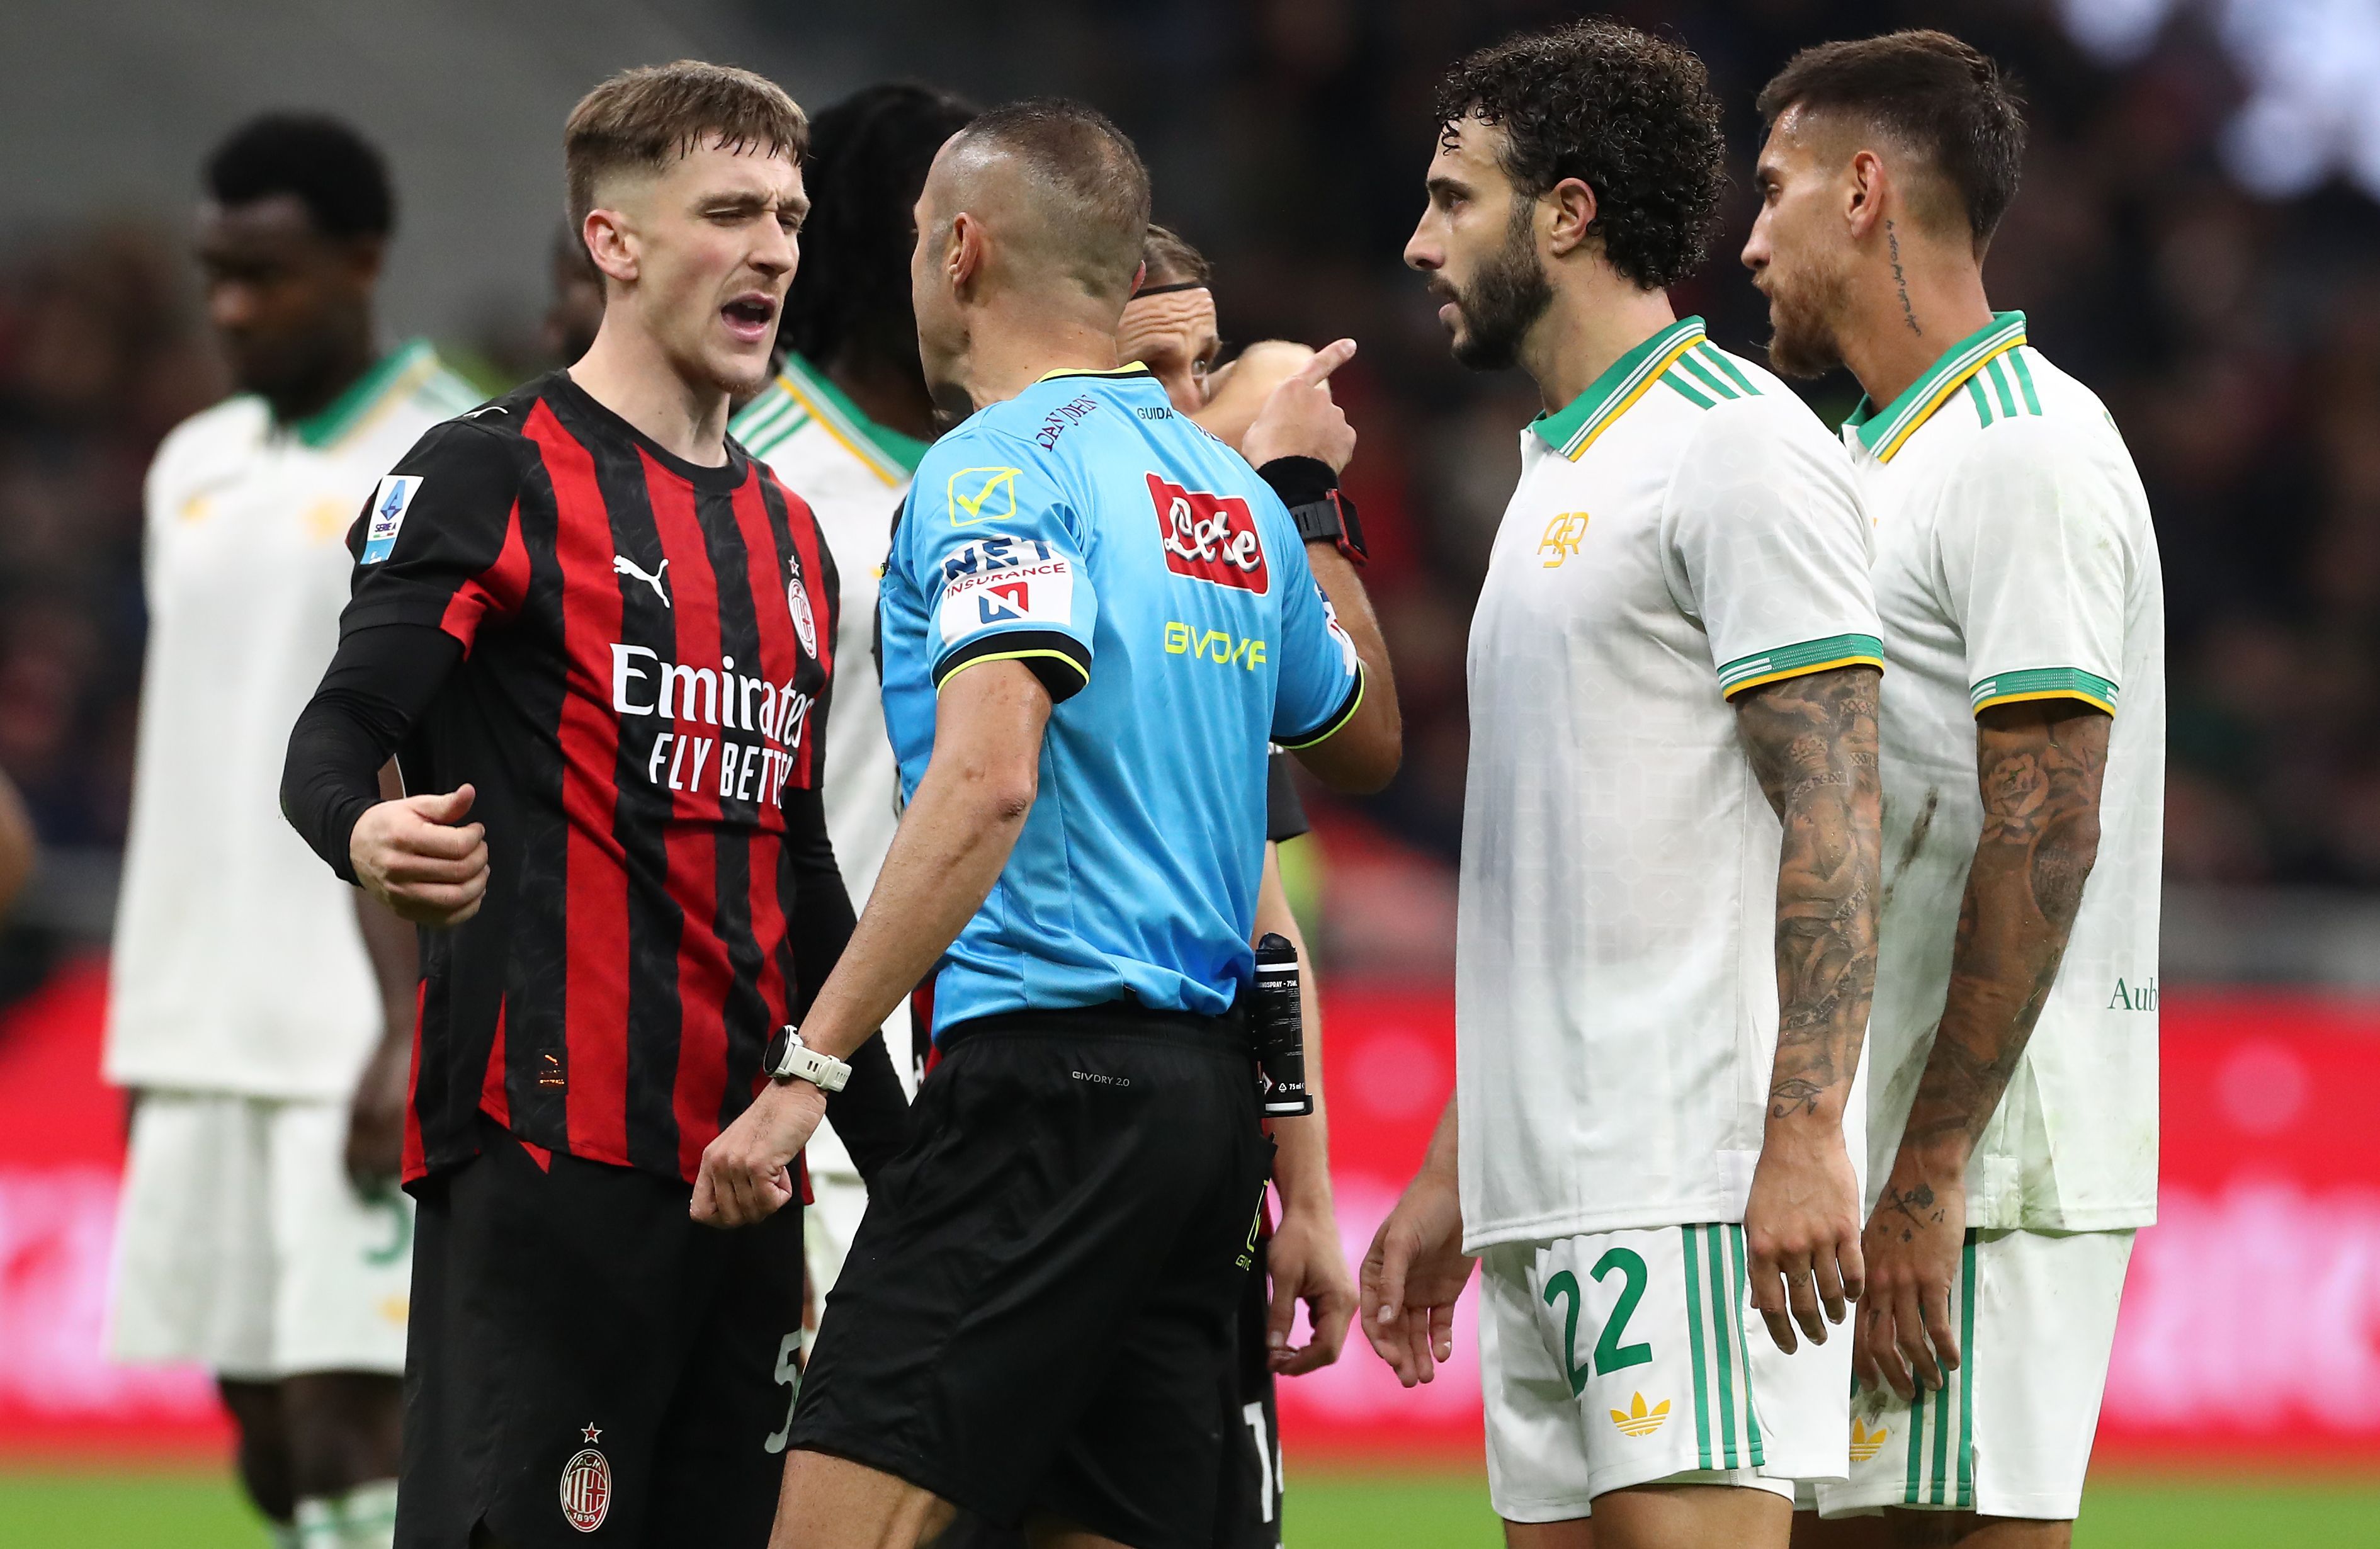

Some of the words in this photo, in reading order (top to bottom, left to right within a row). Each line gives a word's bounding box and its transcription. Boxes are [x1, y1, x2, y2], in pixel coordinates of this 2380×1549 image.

[1036, 412, 1068, 452] DAN
[1056, 395, 1098, 426] JOHN
[1136, 407, 1174, 420] GUIDA
[1164, 496, 1261, 572] Lete
[946, 562, 1067, 599] INSURANCE
[609, 643, 815, 748] Emirates
[649, 732, 713, 792] FLY
[1072, 1071, 1113, 1084] GIVDRY
[1116, 1077, 1130, 1087] 2.0
[1543, 1247, 1653, 1399] 22
[575, 1455, 601, 1472] ACM
[1243, 1401, 1284, 1523] 1
[572, 1512, 596, 1523] 1899
